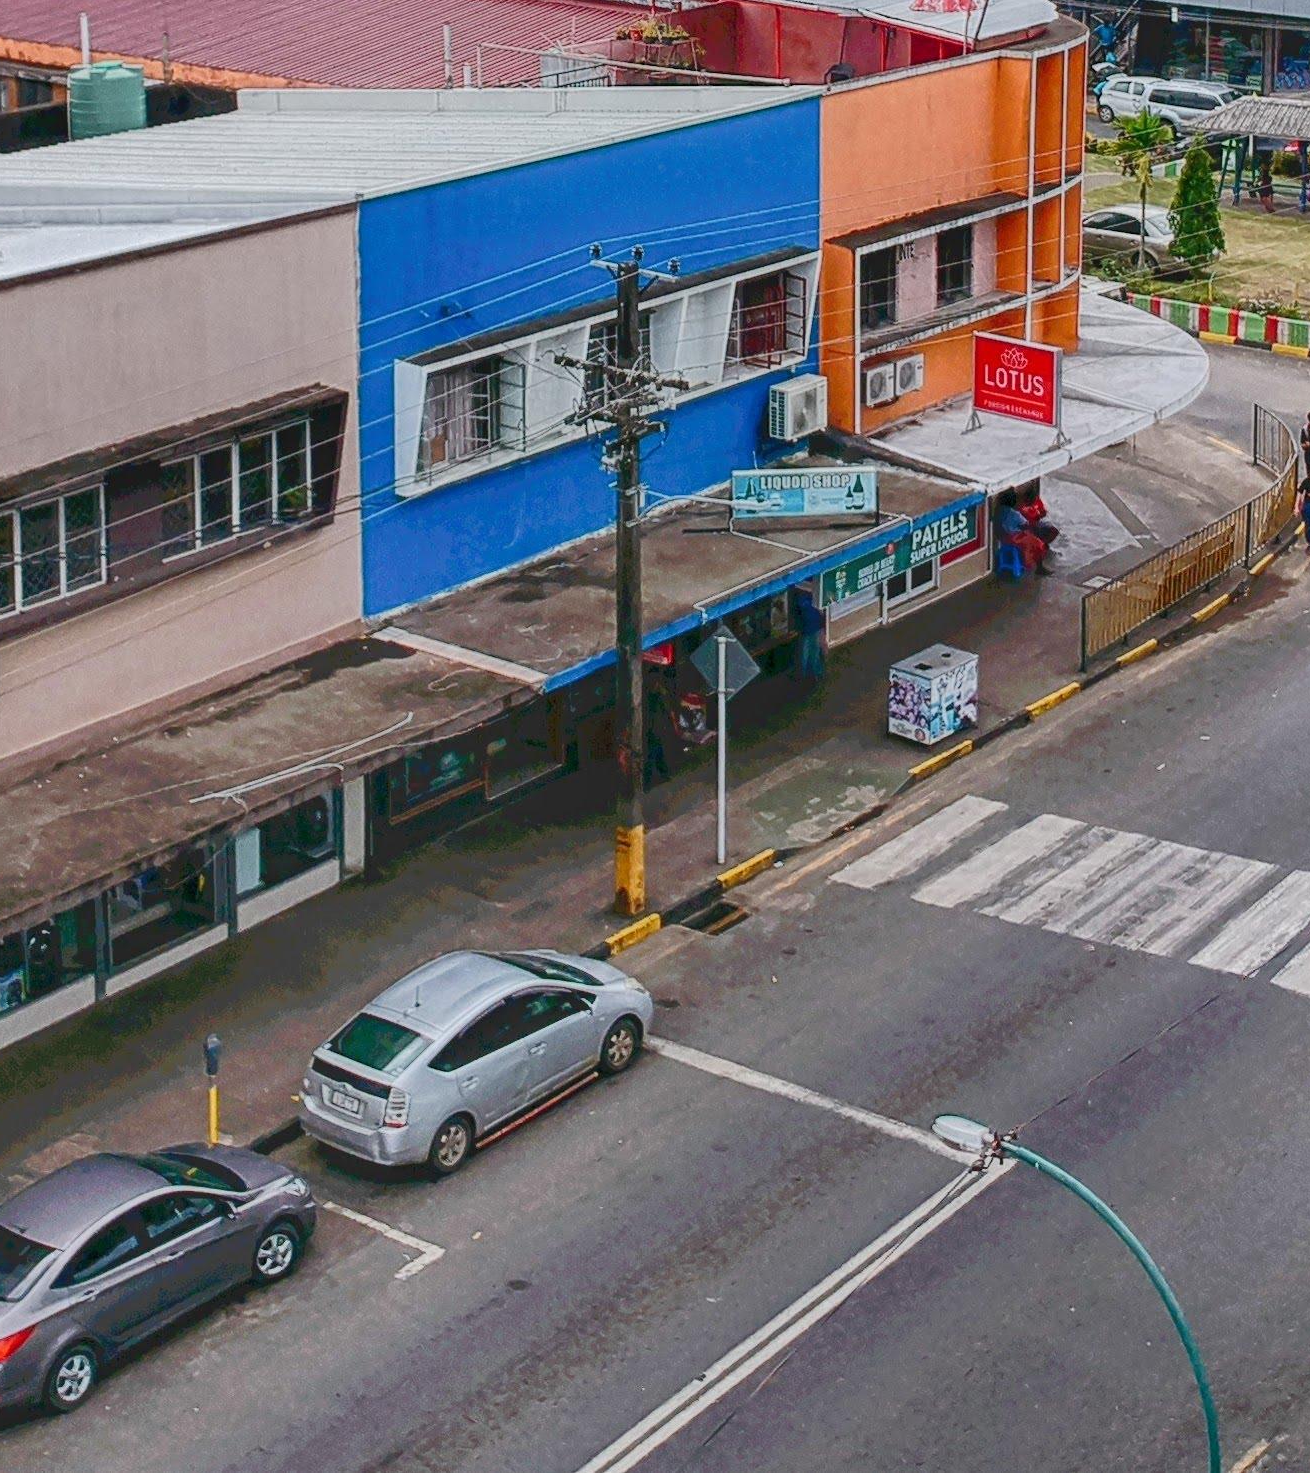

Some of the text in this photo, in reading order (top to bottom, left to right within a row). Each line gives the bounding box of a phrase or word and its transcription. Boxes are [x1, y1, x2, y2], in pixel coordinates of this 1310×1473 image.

[984, 364, 1044, 396] LOTUS
[759, 474, 851, 491] LIQUOR SHOP
[911, 509, 968, 550] PATELS
[910, 529, 969, 565] SUPER LIQUOR
